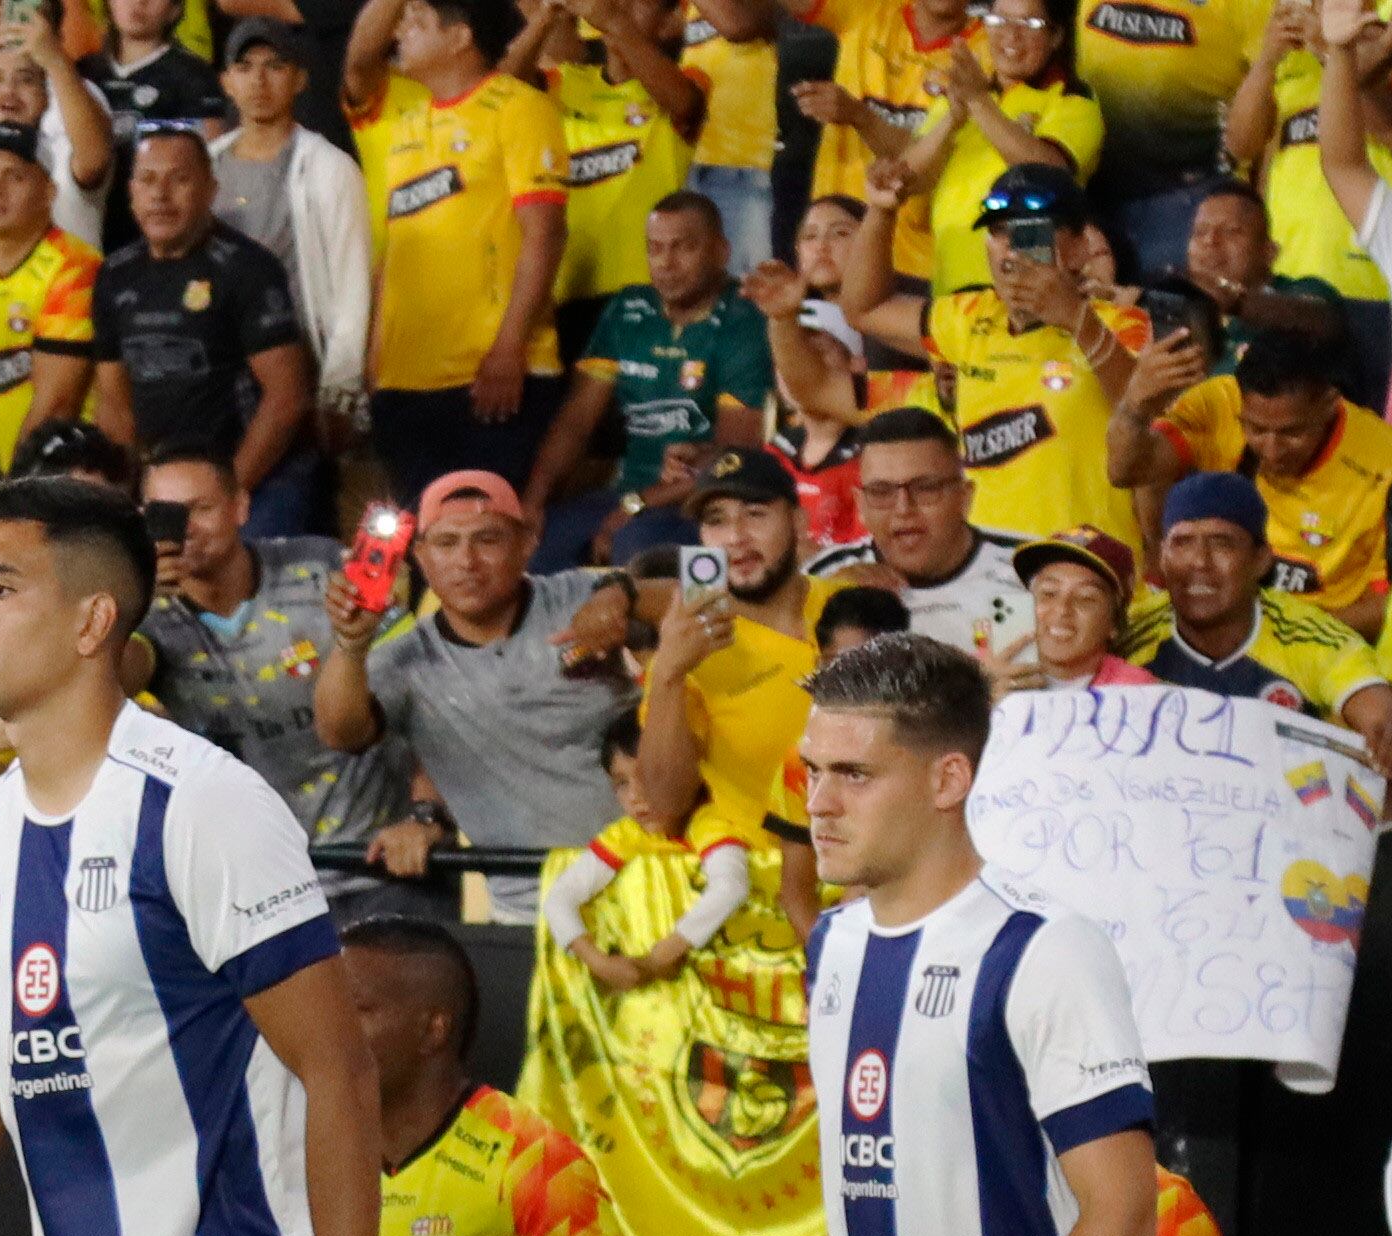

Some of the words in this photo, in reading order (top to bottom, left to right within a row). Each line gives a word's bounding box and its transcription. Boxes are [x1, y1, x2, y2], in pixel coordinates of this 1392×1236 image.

[1095, 4, 1186, 40] PILSENER
[965, 411, 1037, 462] PILSENER
[10, 1072, 94, 1099] Argentina
[840, 1134, 896, 1168] ICBC
[841, 1177, 899, 1201] Argentina
